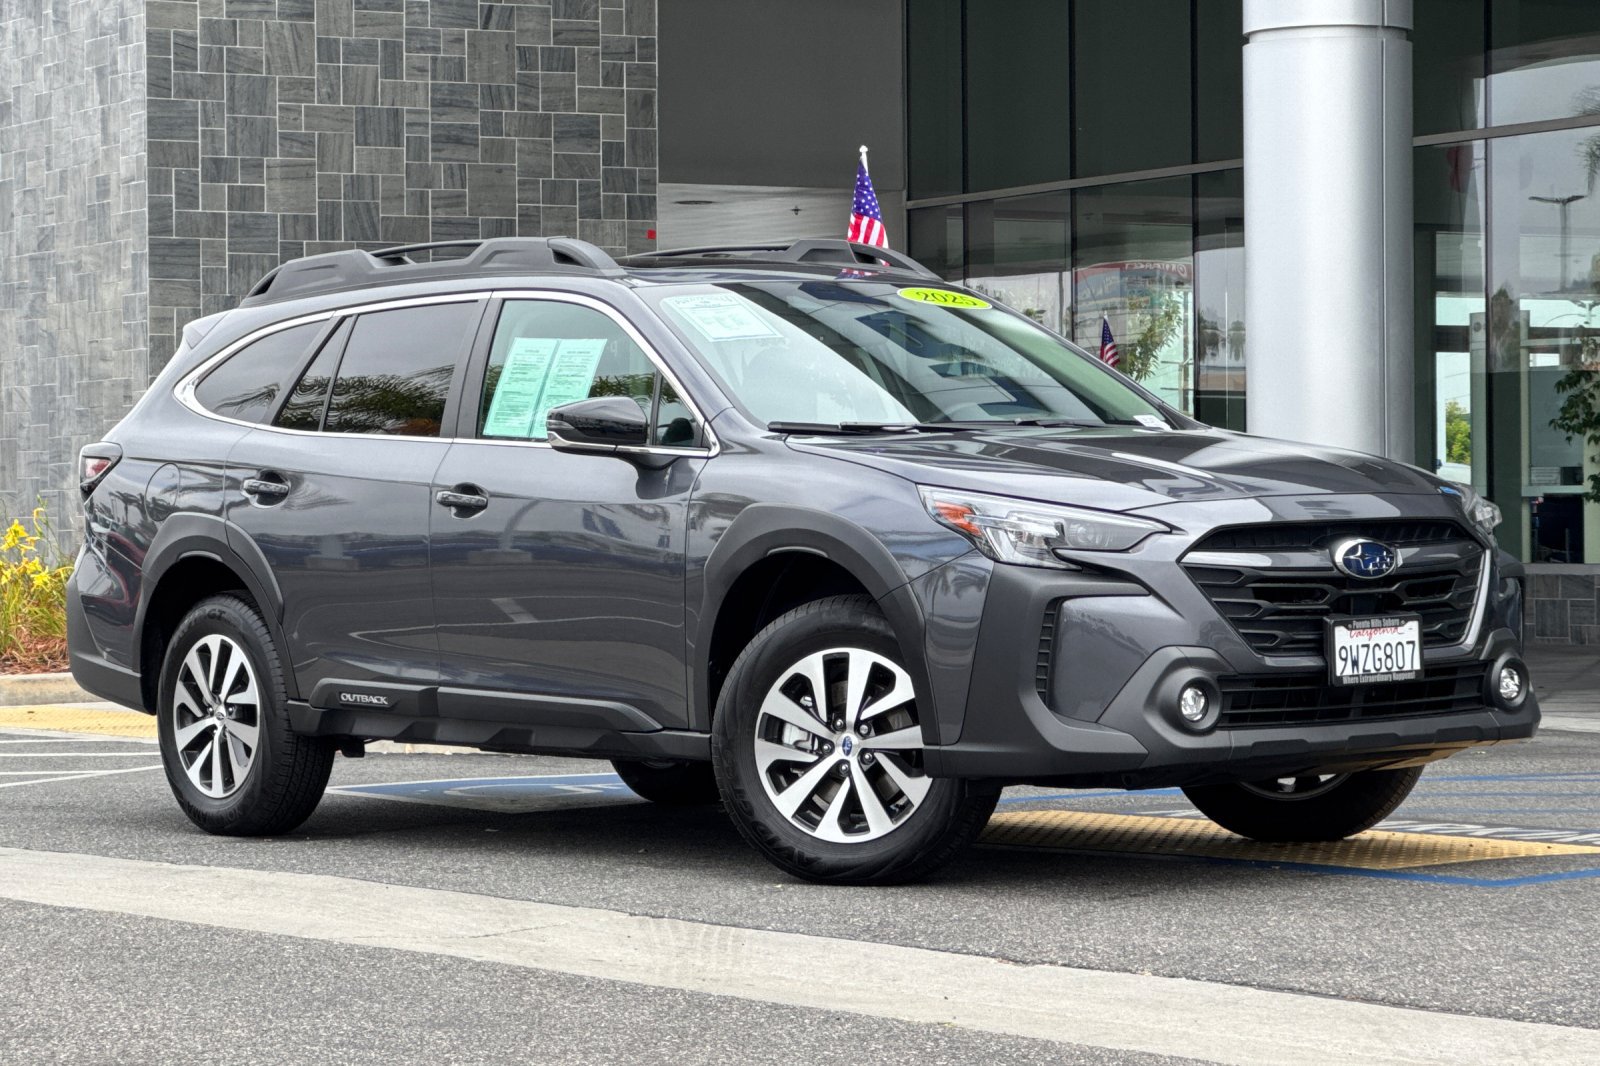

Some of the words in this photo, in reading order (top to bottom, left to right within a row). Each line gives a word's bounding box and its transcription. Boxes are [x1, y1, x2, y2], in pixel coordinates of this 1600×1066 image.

[915, 291, 978, 307] 2025
[1371, 618, 1382, 628] Hills
[1382, 618, 1400, 627] Subaru
[1338, 641, 1416, 676] 9WZG807
[340, 692, 388, 704] OUTBACK
